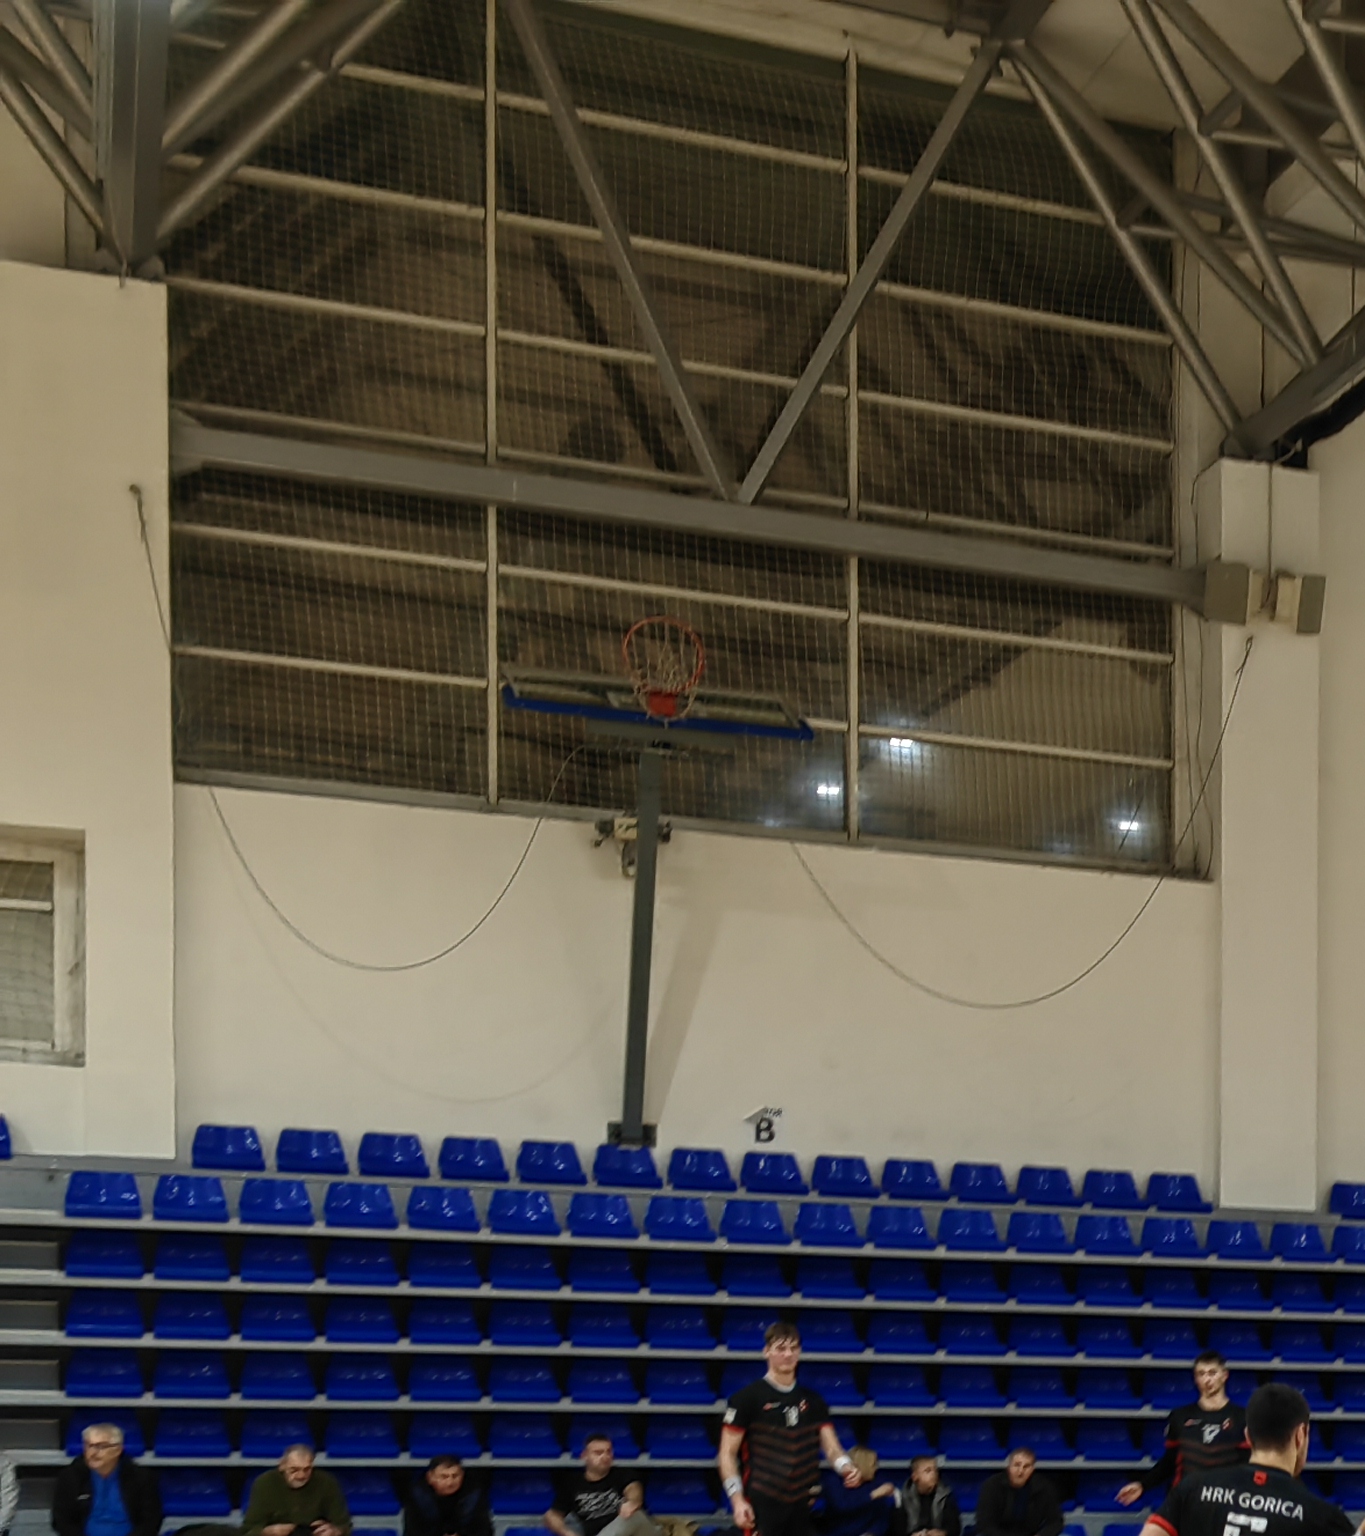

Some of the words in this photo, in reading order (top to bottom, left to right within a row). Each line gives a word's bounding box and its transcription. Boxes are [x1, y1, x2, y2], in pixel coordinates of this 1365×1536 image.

[755, 1117, 776, 1144] B
[1200, 1485, 1236, 1506] HRK
[1238, 1491, 1304, 1522] GORICA
